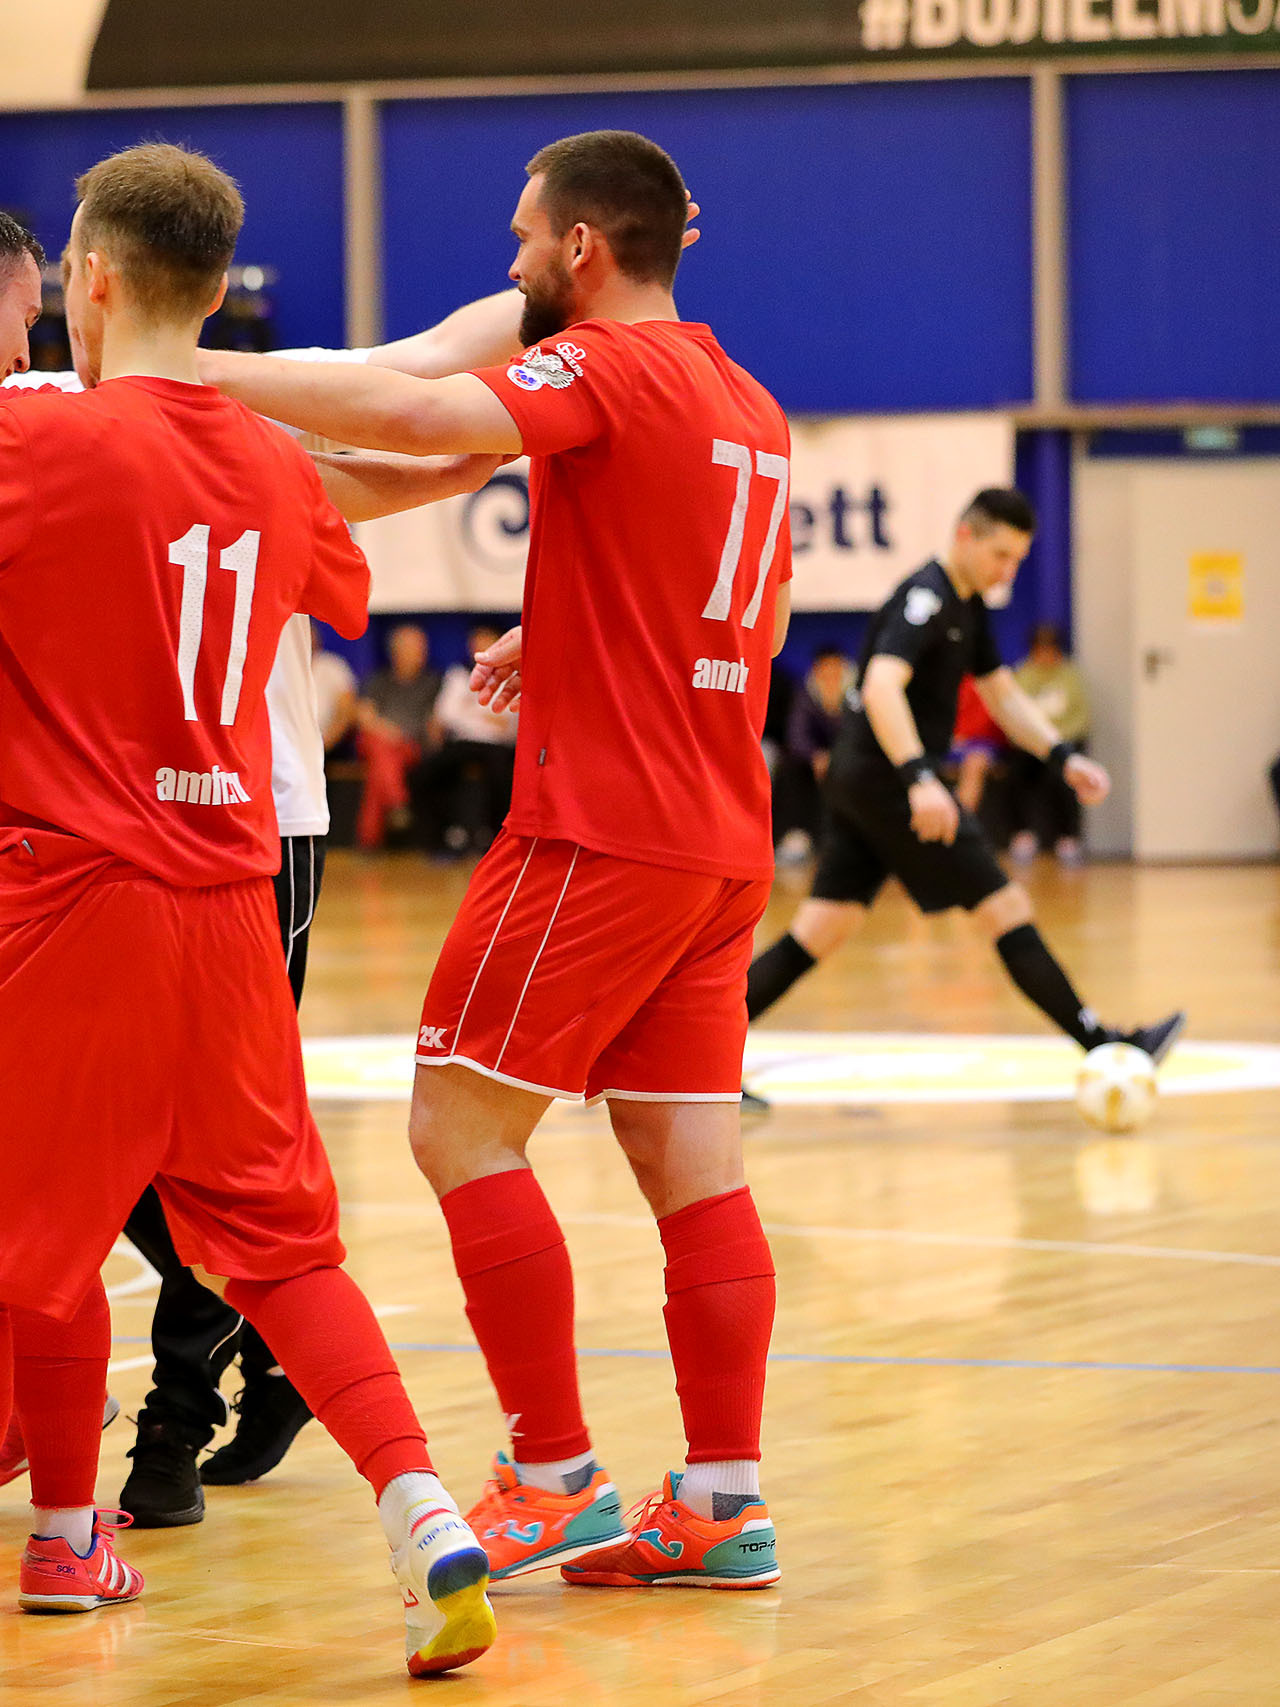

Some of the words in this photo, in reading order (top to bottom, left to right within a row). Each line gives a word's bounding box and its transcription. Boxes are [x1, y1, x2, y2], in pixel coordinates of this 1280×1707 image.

[167, 523, 262, 726] 11
[701, 438, 790, 630] 77
[418, 1025, 448, 1049] 2K
